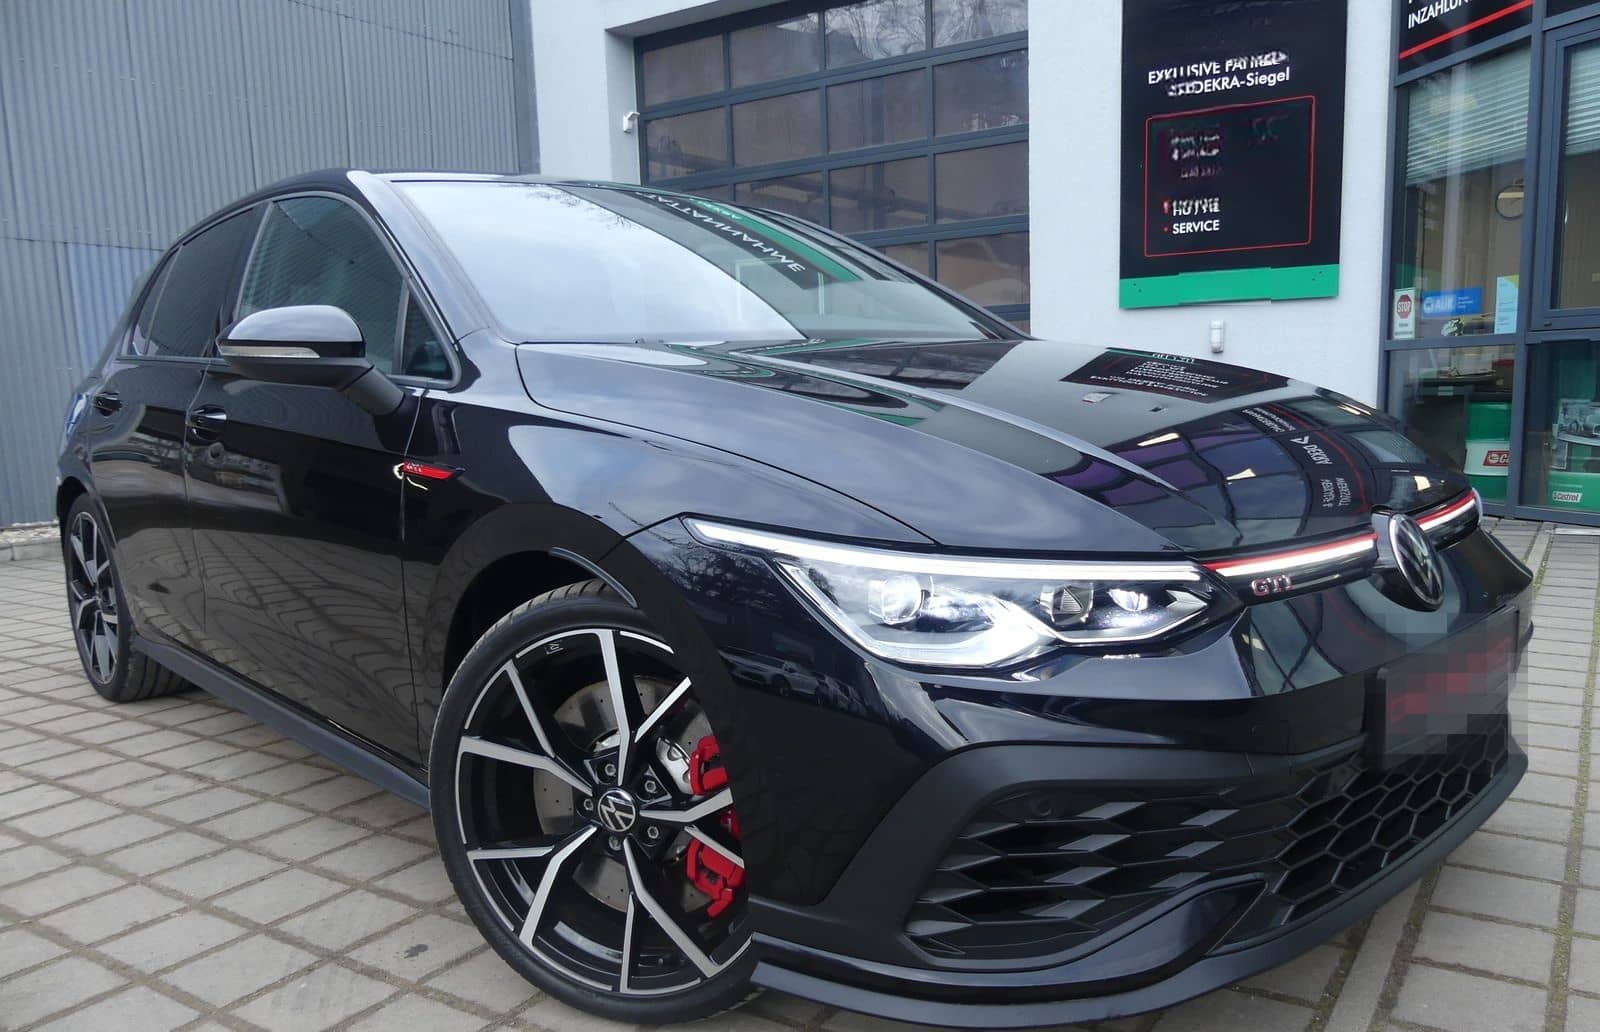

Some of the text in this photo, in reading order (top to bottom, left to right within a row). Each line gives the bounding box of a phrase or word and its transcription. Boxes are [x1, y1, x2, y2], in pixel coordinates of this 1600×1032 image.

[1172, 219, 1221, 235] SERVICE
[1397, 300, 1412, 313] STOP
[1251, 574, 1294, 597] GTI
